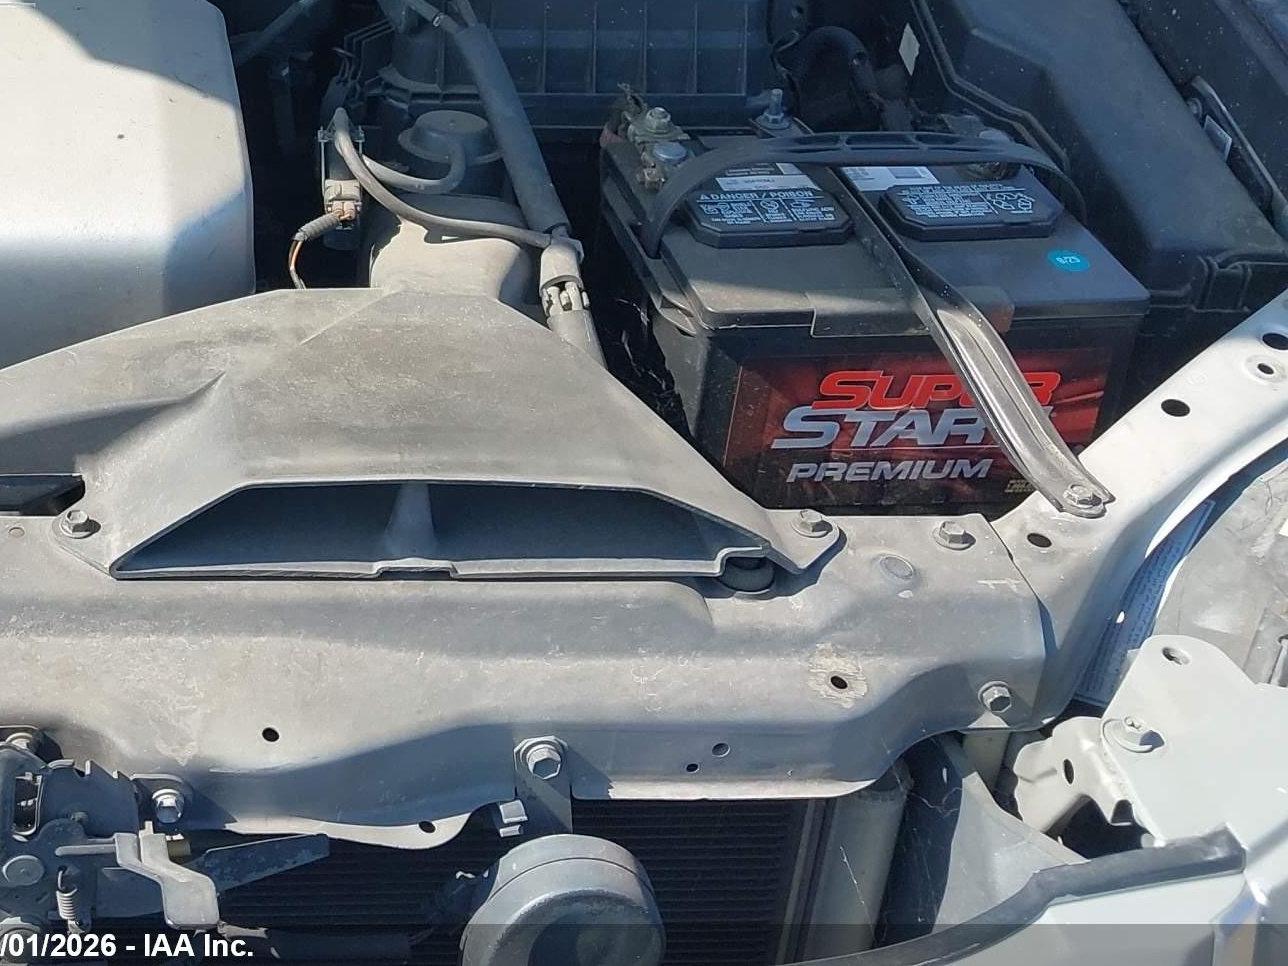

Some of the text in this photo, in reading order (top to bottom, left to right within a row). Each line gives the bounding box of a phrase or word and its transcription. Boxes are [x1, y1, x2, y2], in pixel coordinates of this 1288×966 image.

[710, 191, 760, 200] DANGER
[812, 370, 1061, 410] SUPR
[786, 458, 994, 483] PREMIUM
